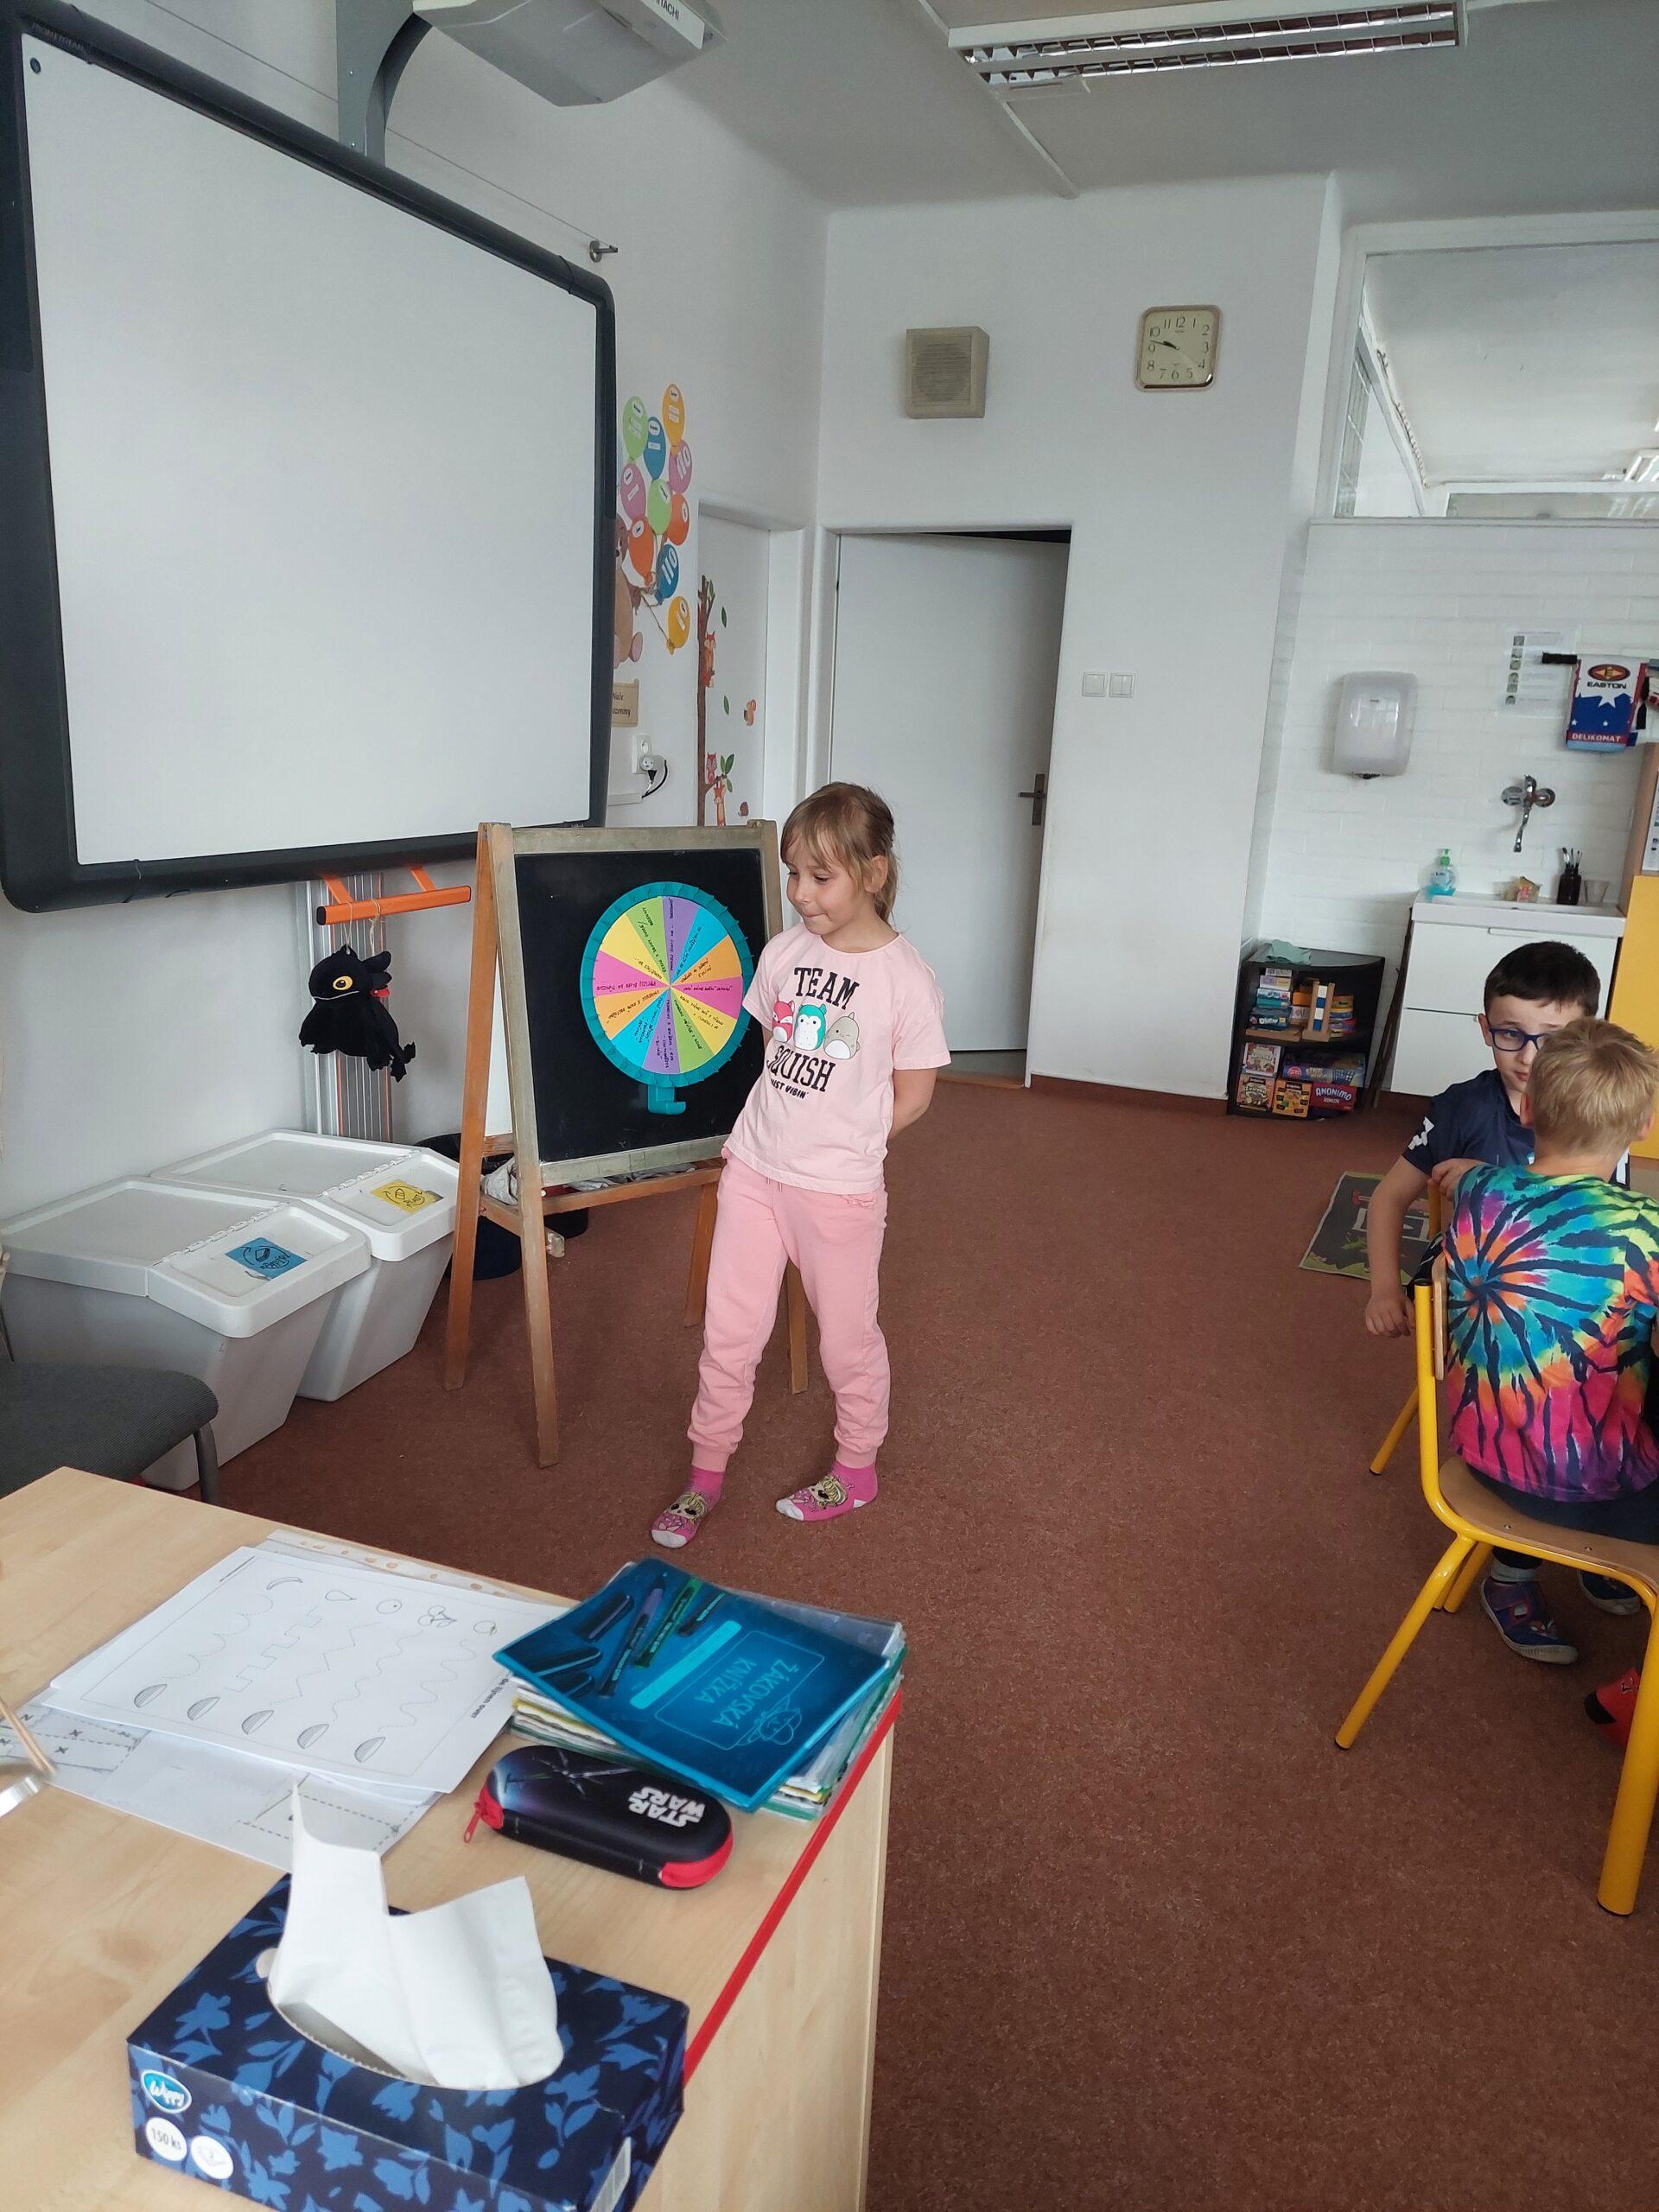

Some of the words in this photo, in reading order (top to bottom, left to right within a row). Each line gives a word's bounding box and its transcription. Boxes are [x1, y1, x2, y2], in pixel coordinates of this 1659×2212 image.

[657, 0, 679, 21] ITACHI
[1164, 318, 1171, 328] 11
[1176, 316, 1185, 328] 12
[1192, 317, 1196, 328] 1
[1149, 326, 1160, 337] 10
[1202, 324, 1210, 335] 2
[1148, 343, 1155, 353] 9
[1203, 341, 1209, 353] 3
[1147, 359, 1154, 371] 8
[1198, 359, 1205, 369] 4
[1160, 368, 1166, 379] 7
[1172, 369, 1179, 380] 6
[1185, 367, 1193, 379] 5
[1587, 681, 1627, 690] EASTON
[794, 967, 860, 1010] TEAM
[766, 1045, 836, 1092] SQUISH
[1315, 1087, 1352, 1101] ANONIMO
[694, 1657, 757, 1703] KNÍŽKA
[712, 1658, 799, 1729] ŽÁKOVSKÁ
[629, 1786, 705, 1818] WARS
[628, 1796, 701, 1827] STAR
[151, 2126, 169, 2145] 150
